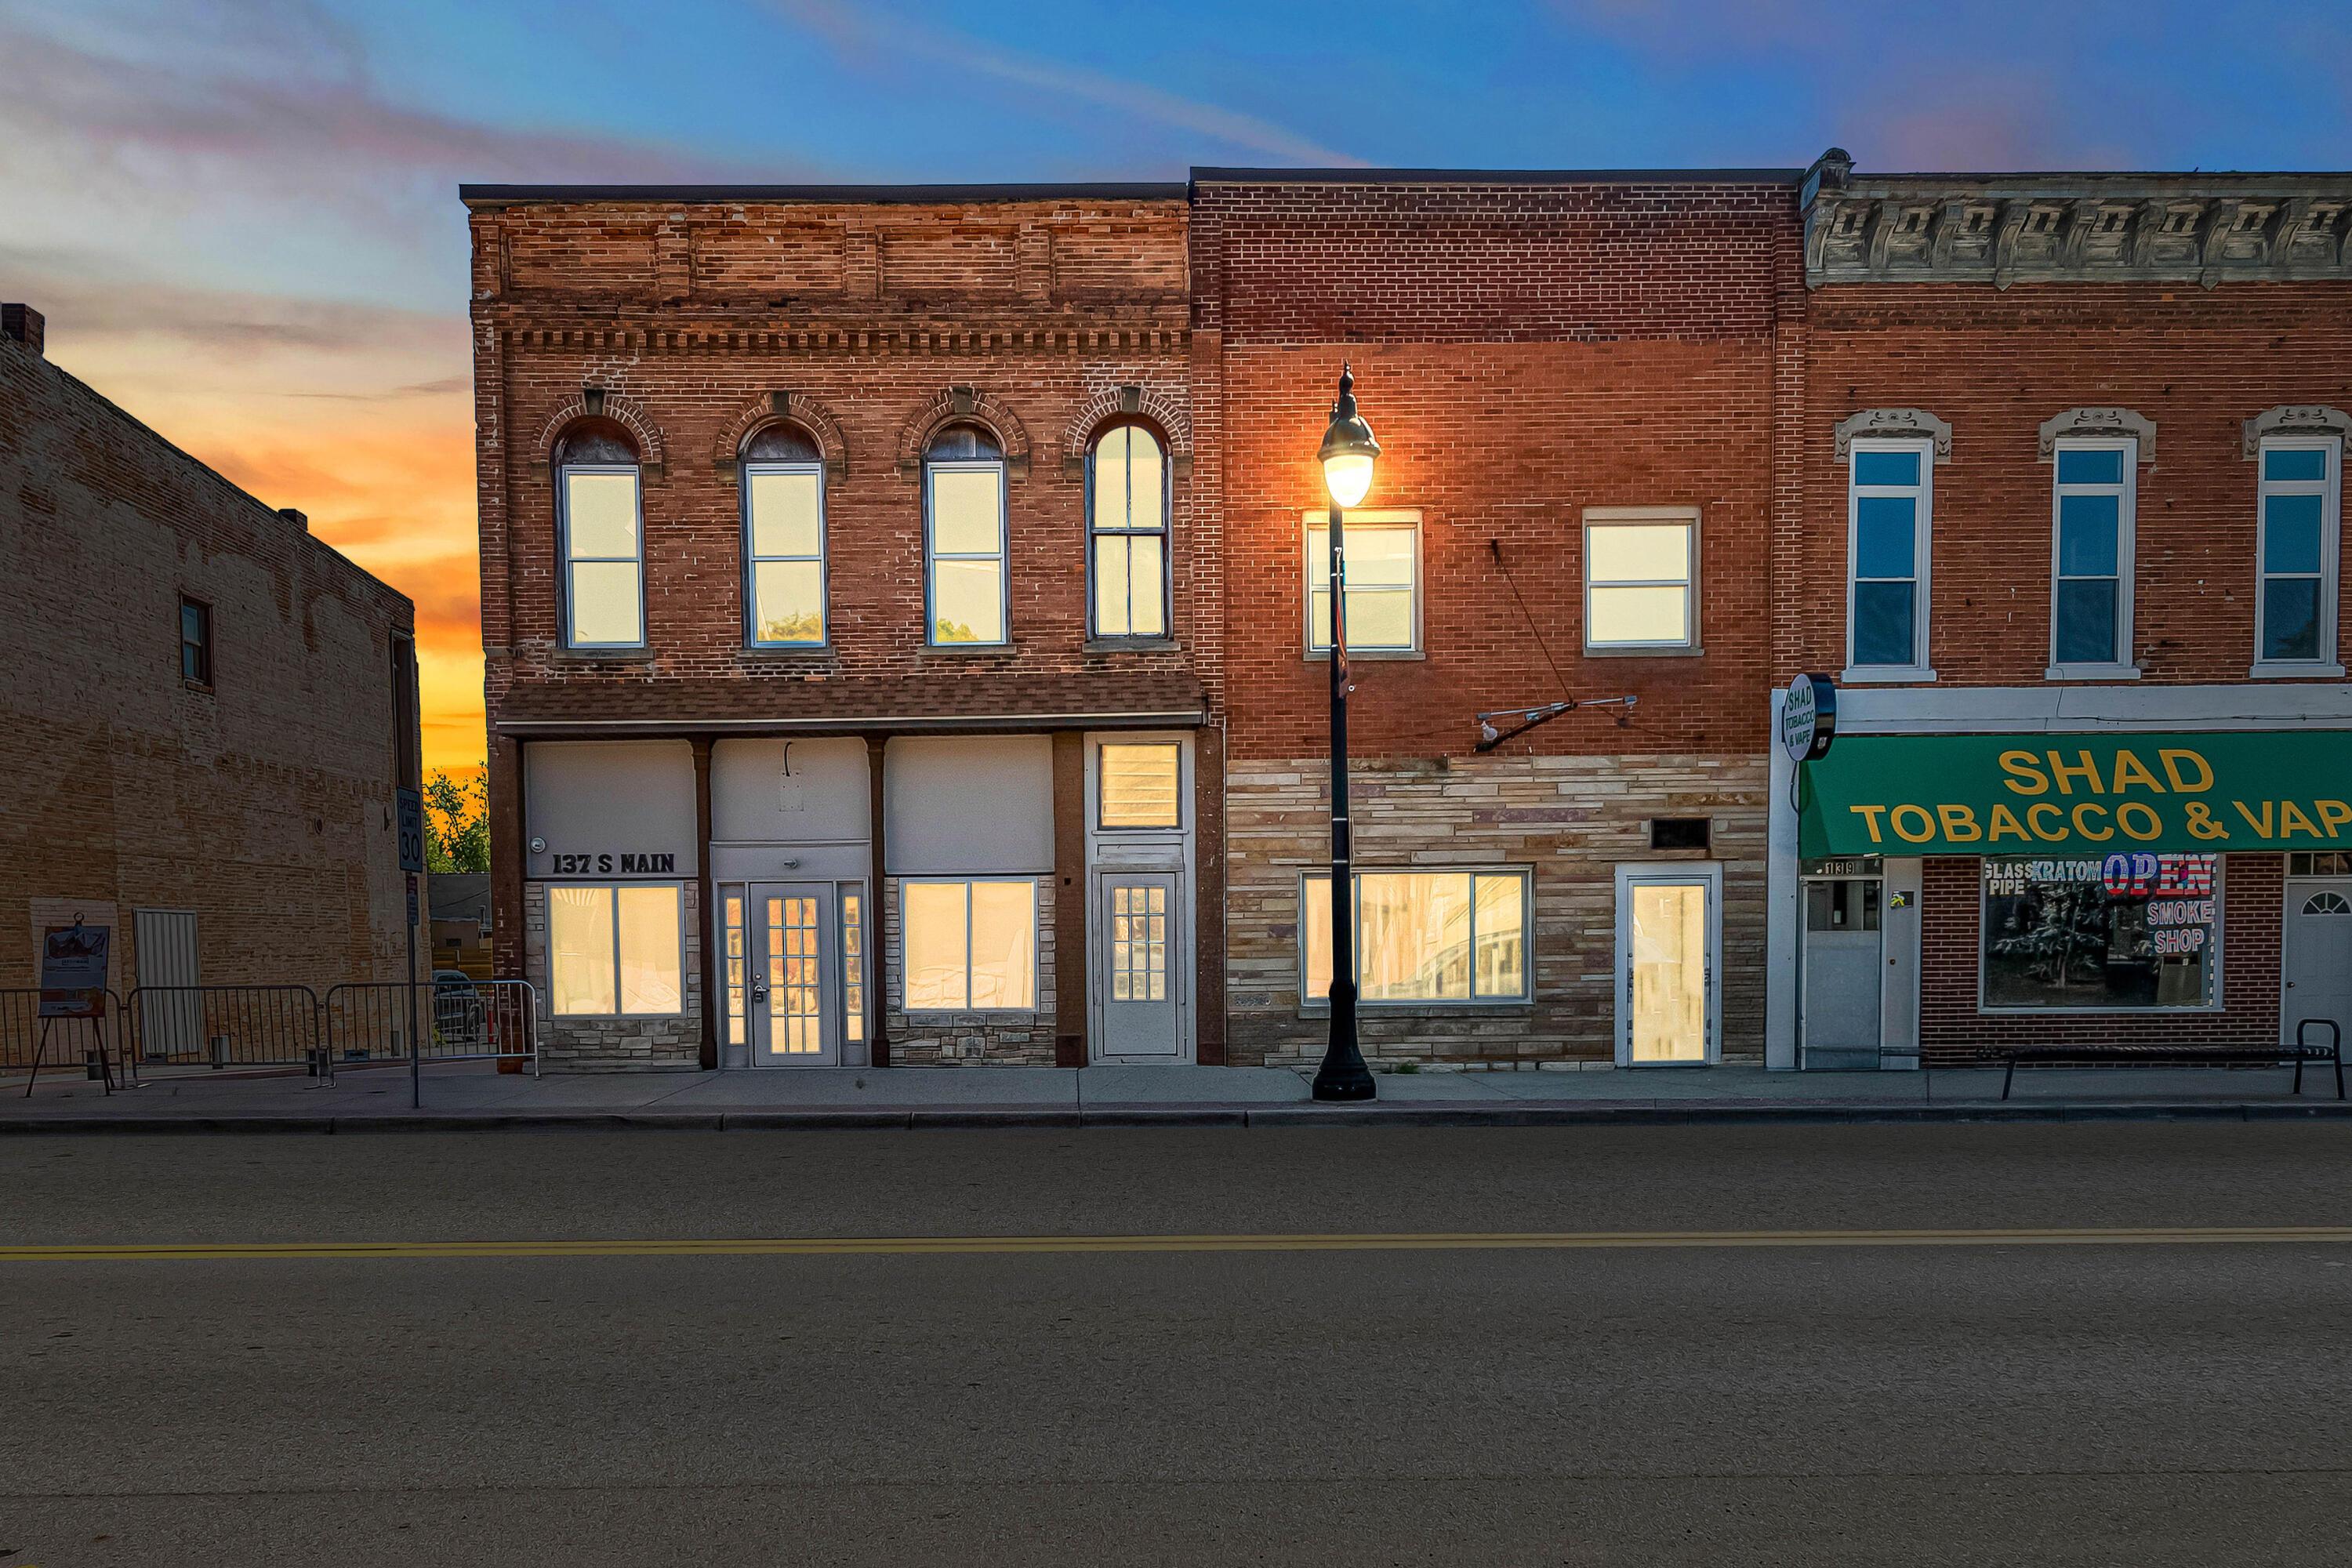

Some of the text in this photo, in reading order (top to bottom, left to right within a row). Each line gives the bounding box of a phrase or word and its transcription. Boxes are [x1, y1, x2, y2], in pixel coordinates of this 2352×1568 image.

[1788, 685, 1812, 712] SHAD
[1785, 710, 1814, 731] TOBACCO
[1789, 729, 1811, 747] & VAPE
[1998, 749, 2215, 796] SHAD
[399, 797, 419, 813] SPEED
[401, 815, 418, 829] LIMIT
[1849, 802, 2164, 843] TOBACCO
[2185, 801, 2230, 840] &
[401, 832, 420, 862] 30
[553, 853, 675, 873] 137 S MAIN
[1825, 862, 1855, 875] 139
[1984, 862, 2032, 879] GLASS
[2031, 861, 2102, 882] KRATOM
[2103, 852, 2217, 897] OPEN
[1989, 879, 2025, 895] PIPE
[2147, 900, 2214, 925] SMOKE
[2154, 928, 2205, 955] SHOP
